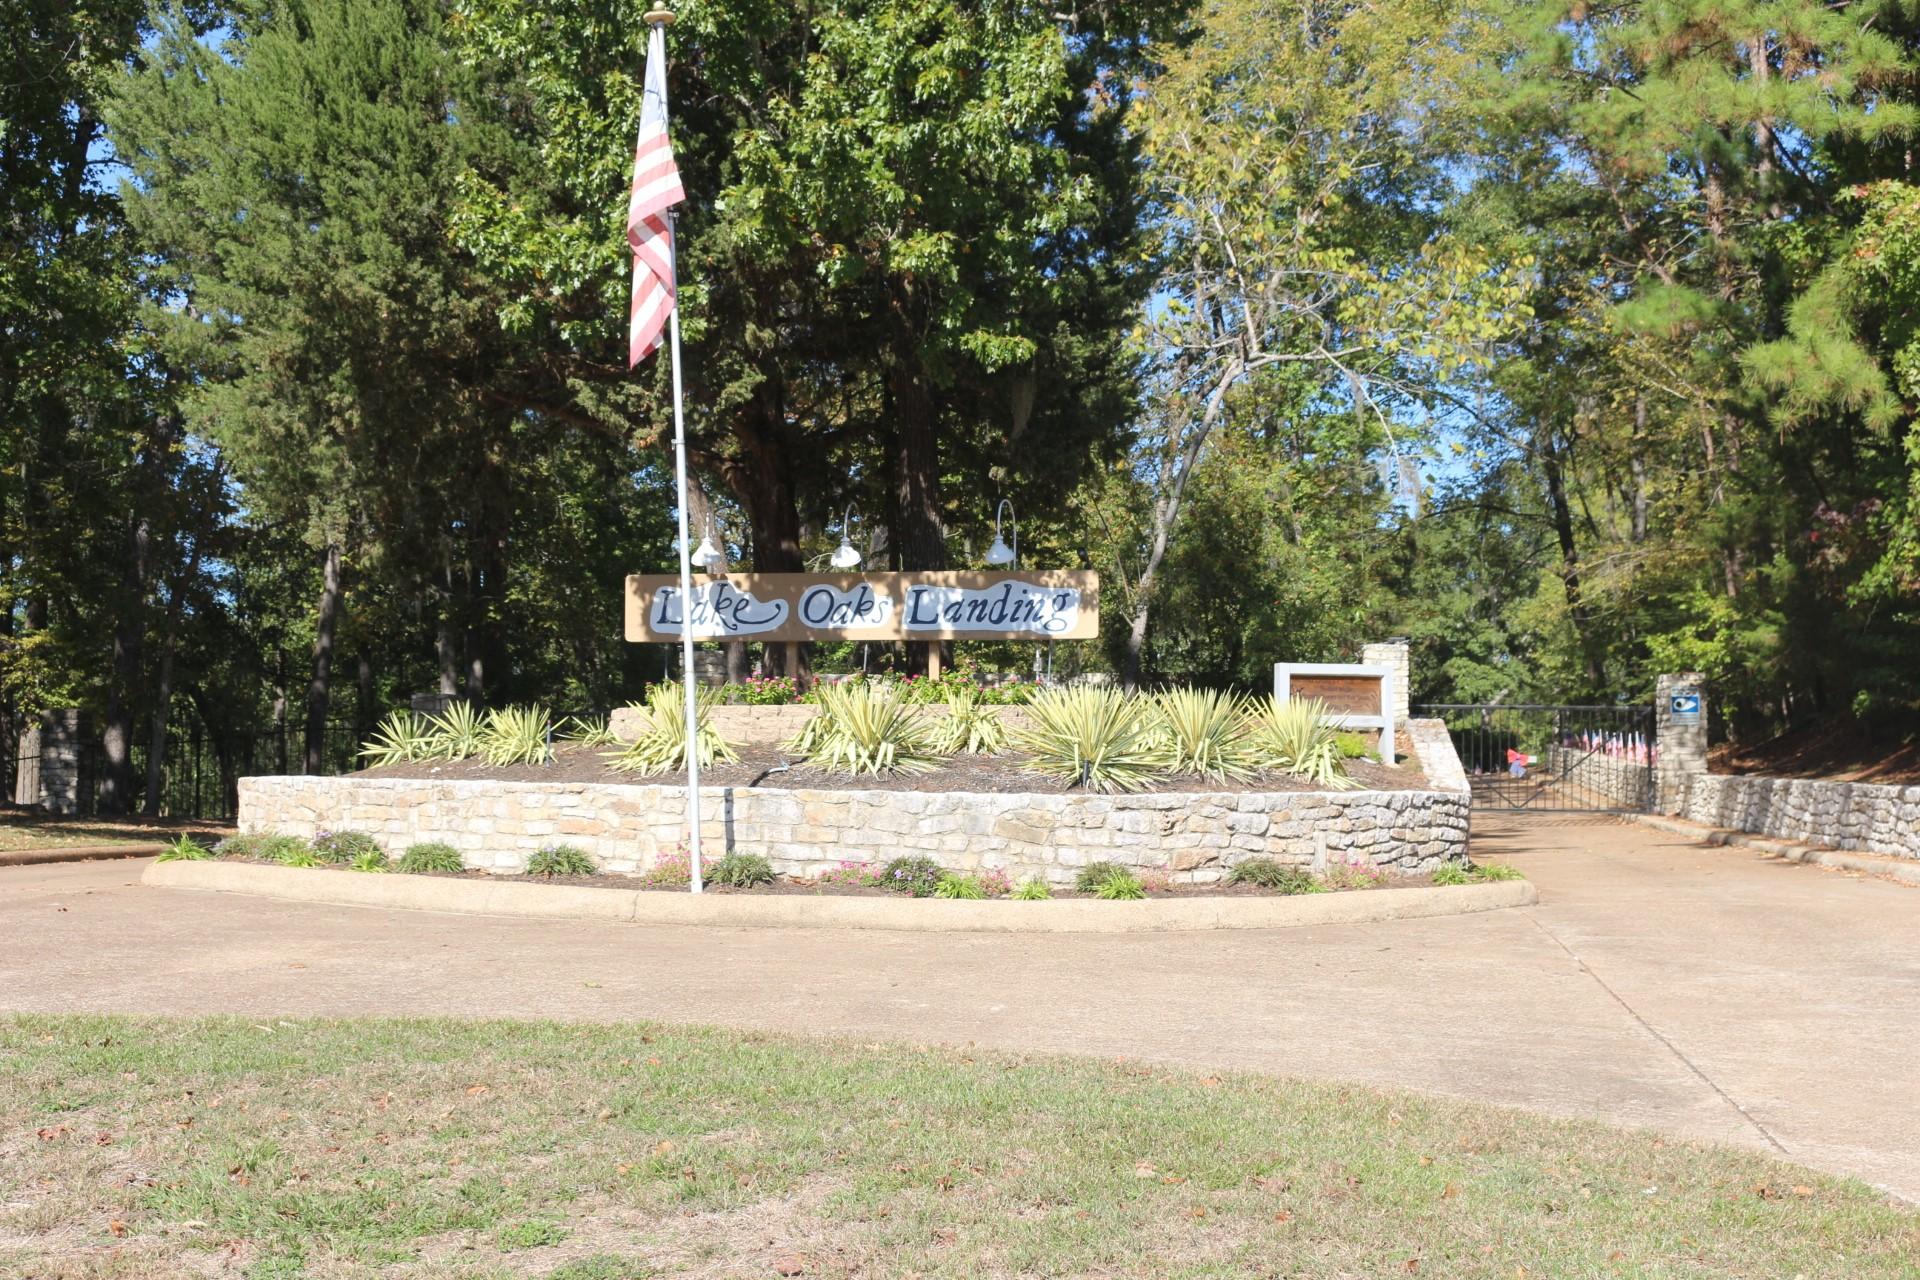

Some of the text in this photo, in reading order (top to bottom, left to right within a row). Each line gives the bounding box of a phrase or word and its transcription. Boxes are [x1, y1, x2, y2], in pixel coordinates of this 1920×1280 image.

[656, 582, 1072, 632] Lake Oaks Landing
